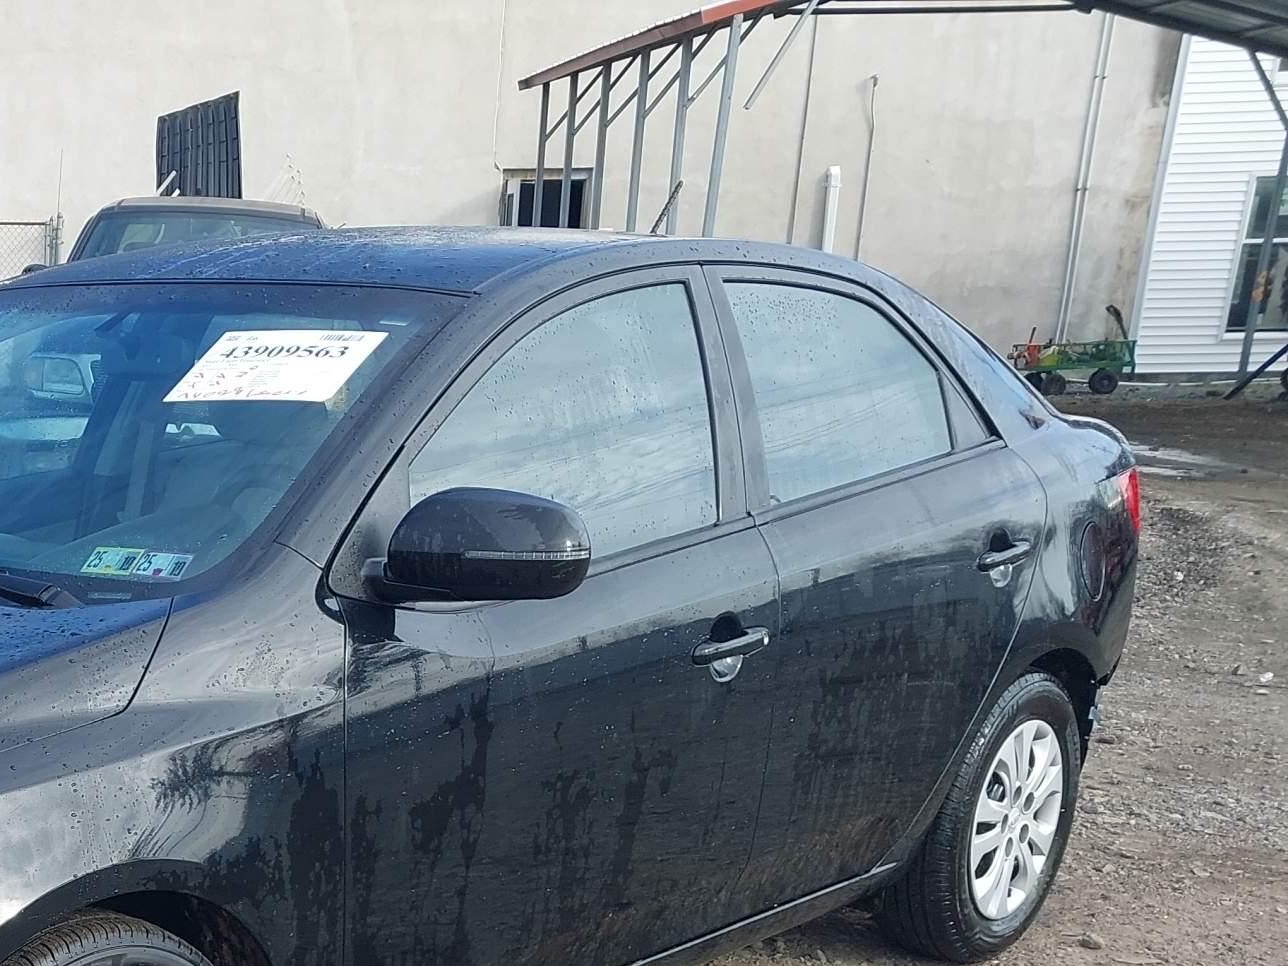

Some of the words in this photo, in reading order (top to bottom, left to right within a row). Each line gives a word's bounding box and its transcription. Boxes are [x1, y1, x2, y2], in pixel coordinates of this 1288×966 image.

[220, 345, 349, 358] 43909563
[87, 551, 108, 568] 25
[137, 553, 157, 571] 25
